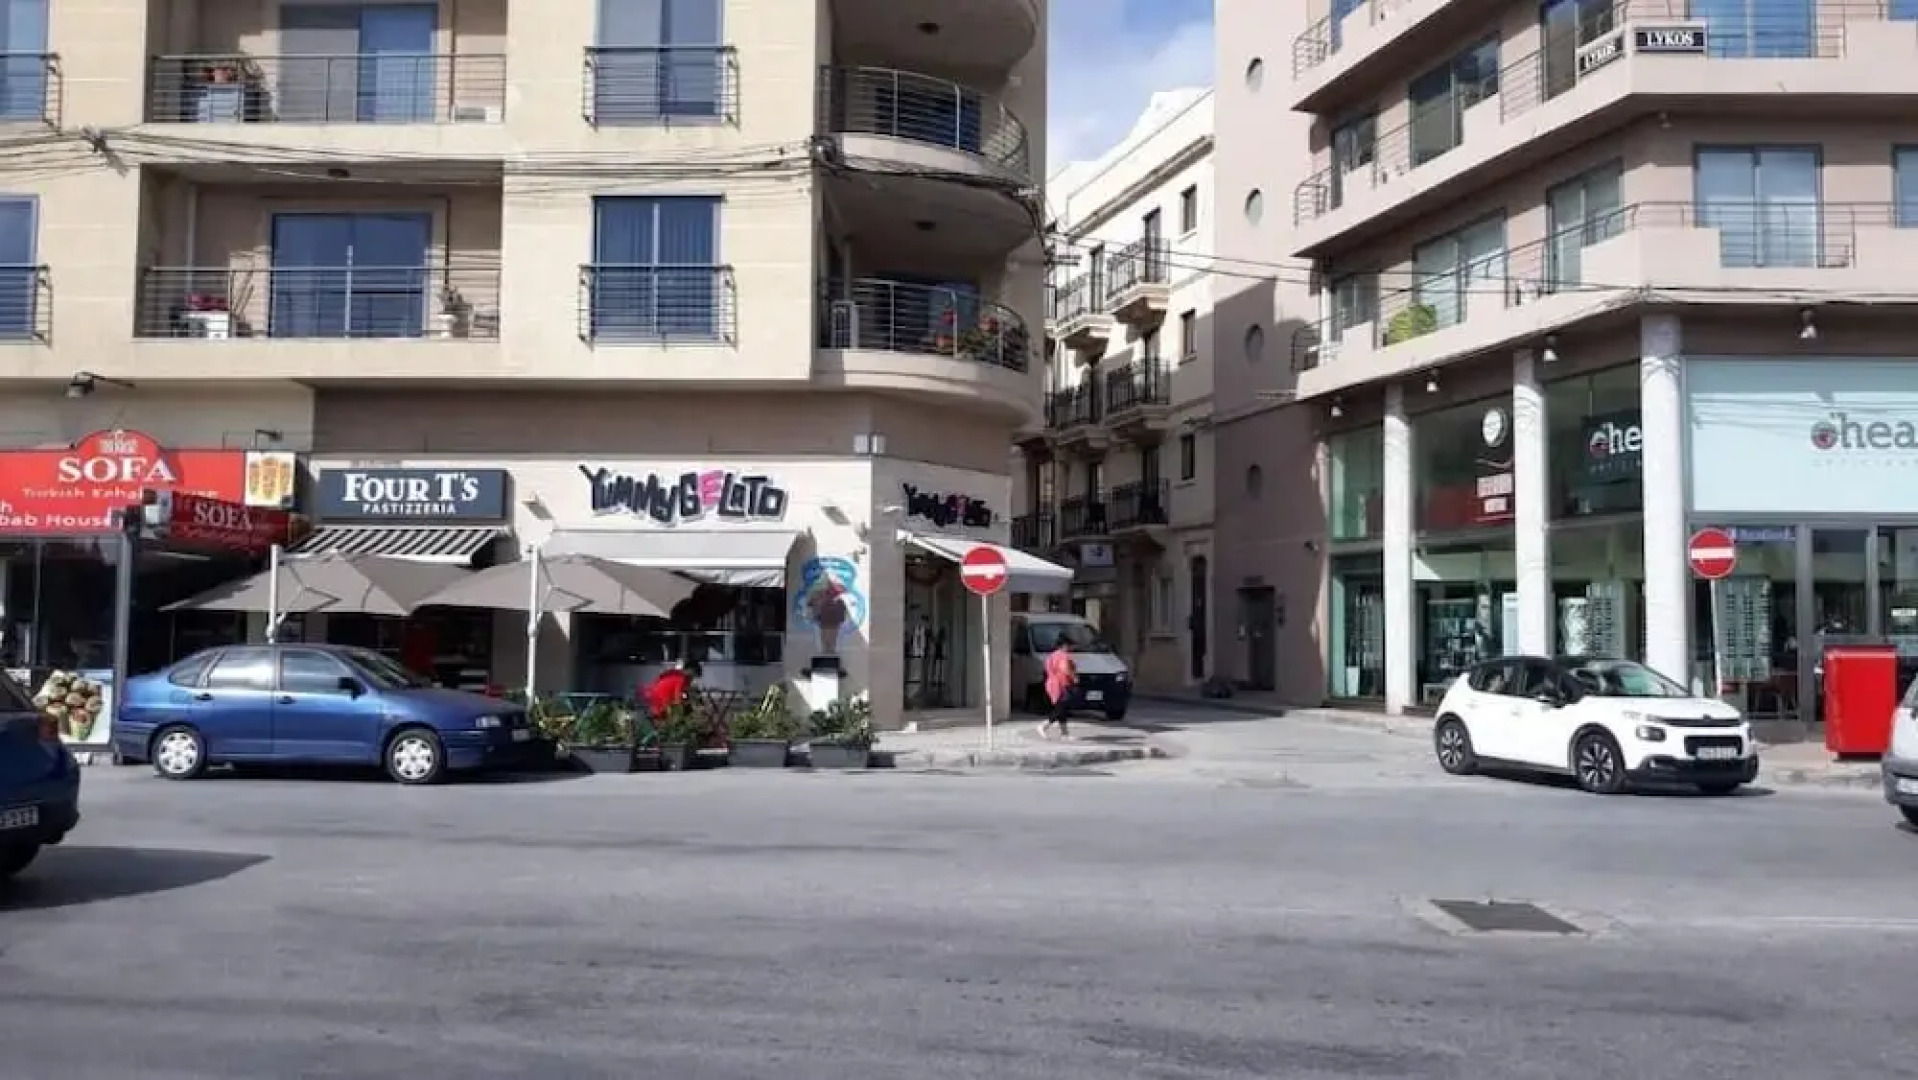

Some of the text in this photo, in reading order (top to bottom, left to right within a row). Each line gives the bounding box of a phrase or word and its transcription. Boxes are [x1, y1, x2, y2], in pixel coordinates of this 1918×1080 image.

[1646, 31, 1694, 47] LYKOS
[58, 456, 177, 483] SOFA
[193, 501, 254, 532] SOFA
[361, 503, 456, 515] PASTIZZERIA
